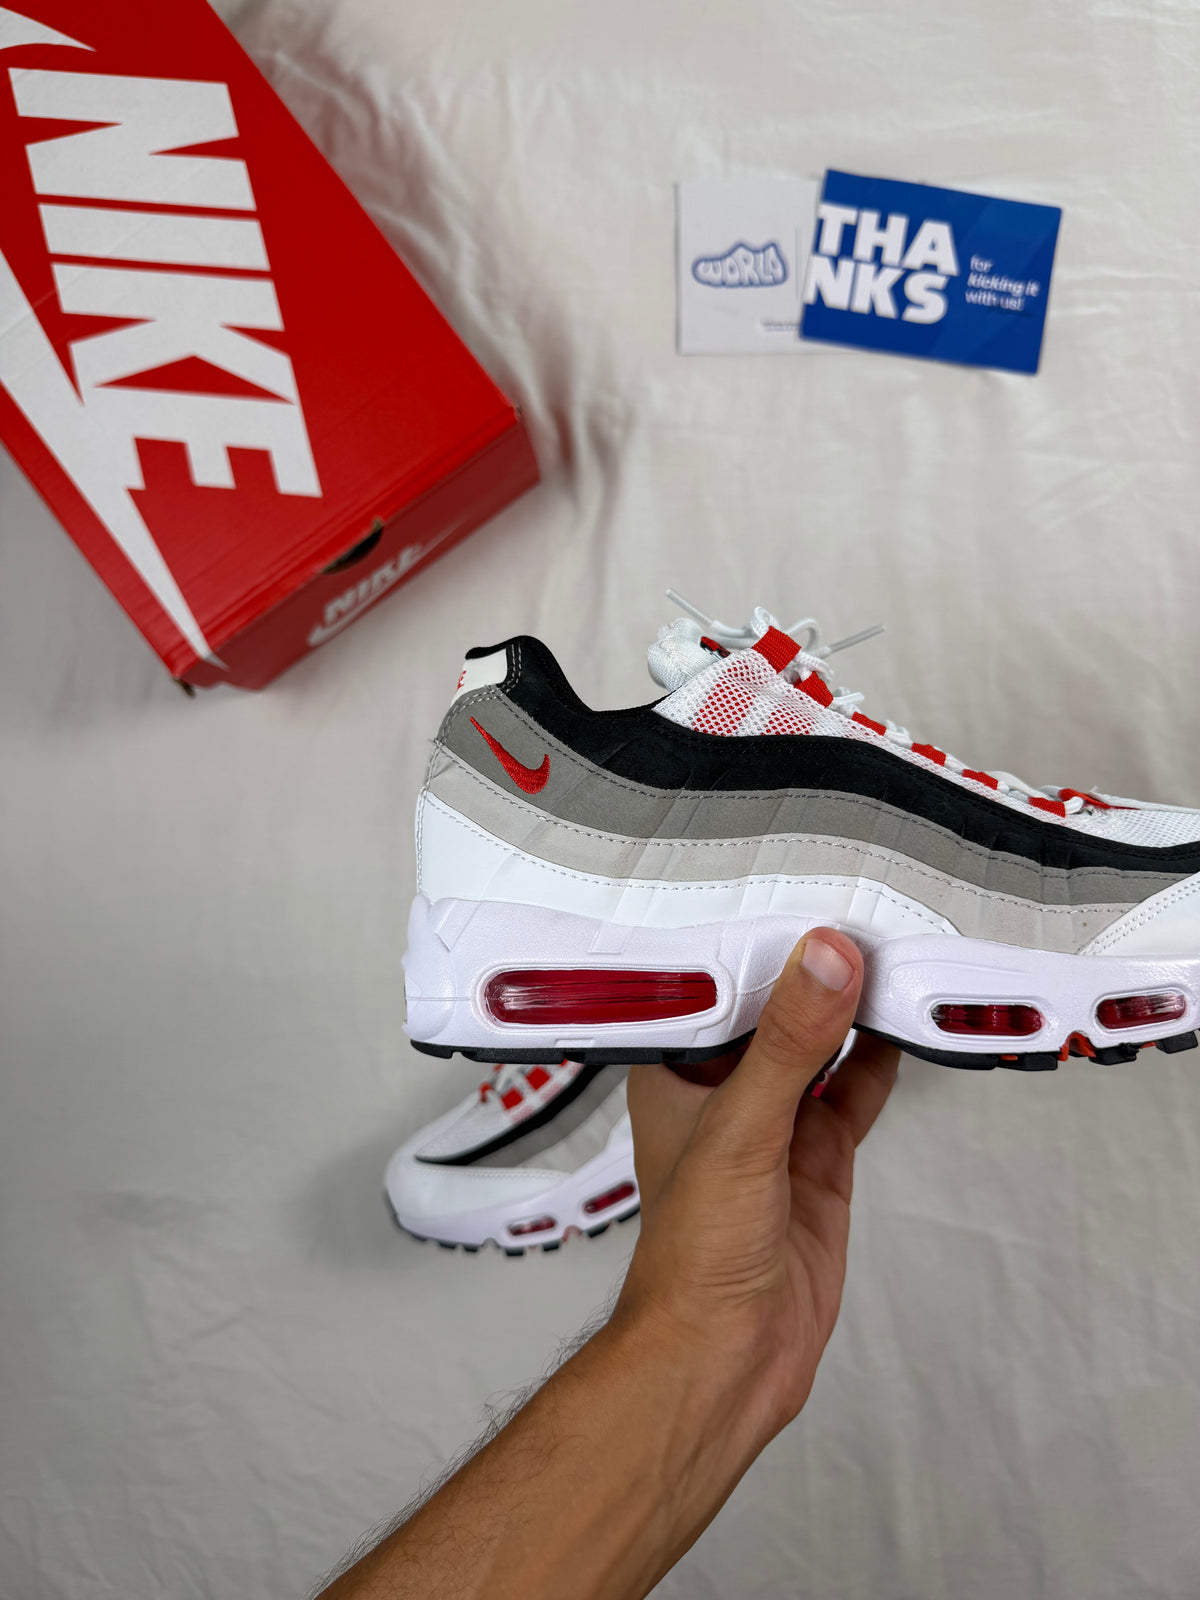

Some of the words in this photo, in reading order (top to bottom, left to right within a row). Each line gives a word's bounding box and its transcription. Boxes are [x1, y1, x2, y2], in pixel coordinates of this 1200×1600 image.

[817, 203, 960, 277] THA
[8, 67, 323, 498] NIKE
[693, 243, 787, 287] WORLD
[967, 272, 1024, 297] kicking
[1025, 280, 1039, 297] it
[970, 255, 993, 273] for
[803, 254, 949, 325] NKS
[965, 290, 999, 307] with
